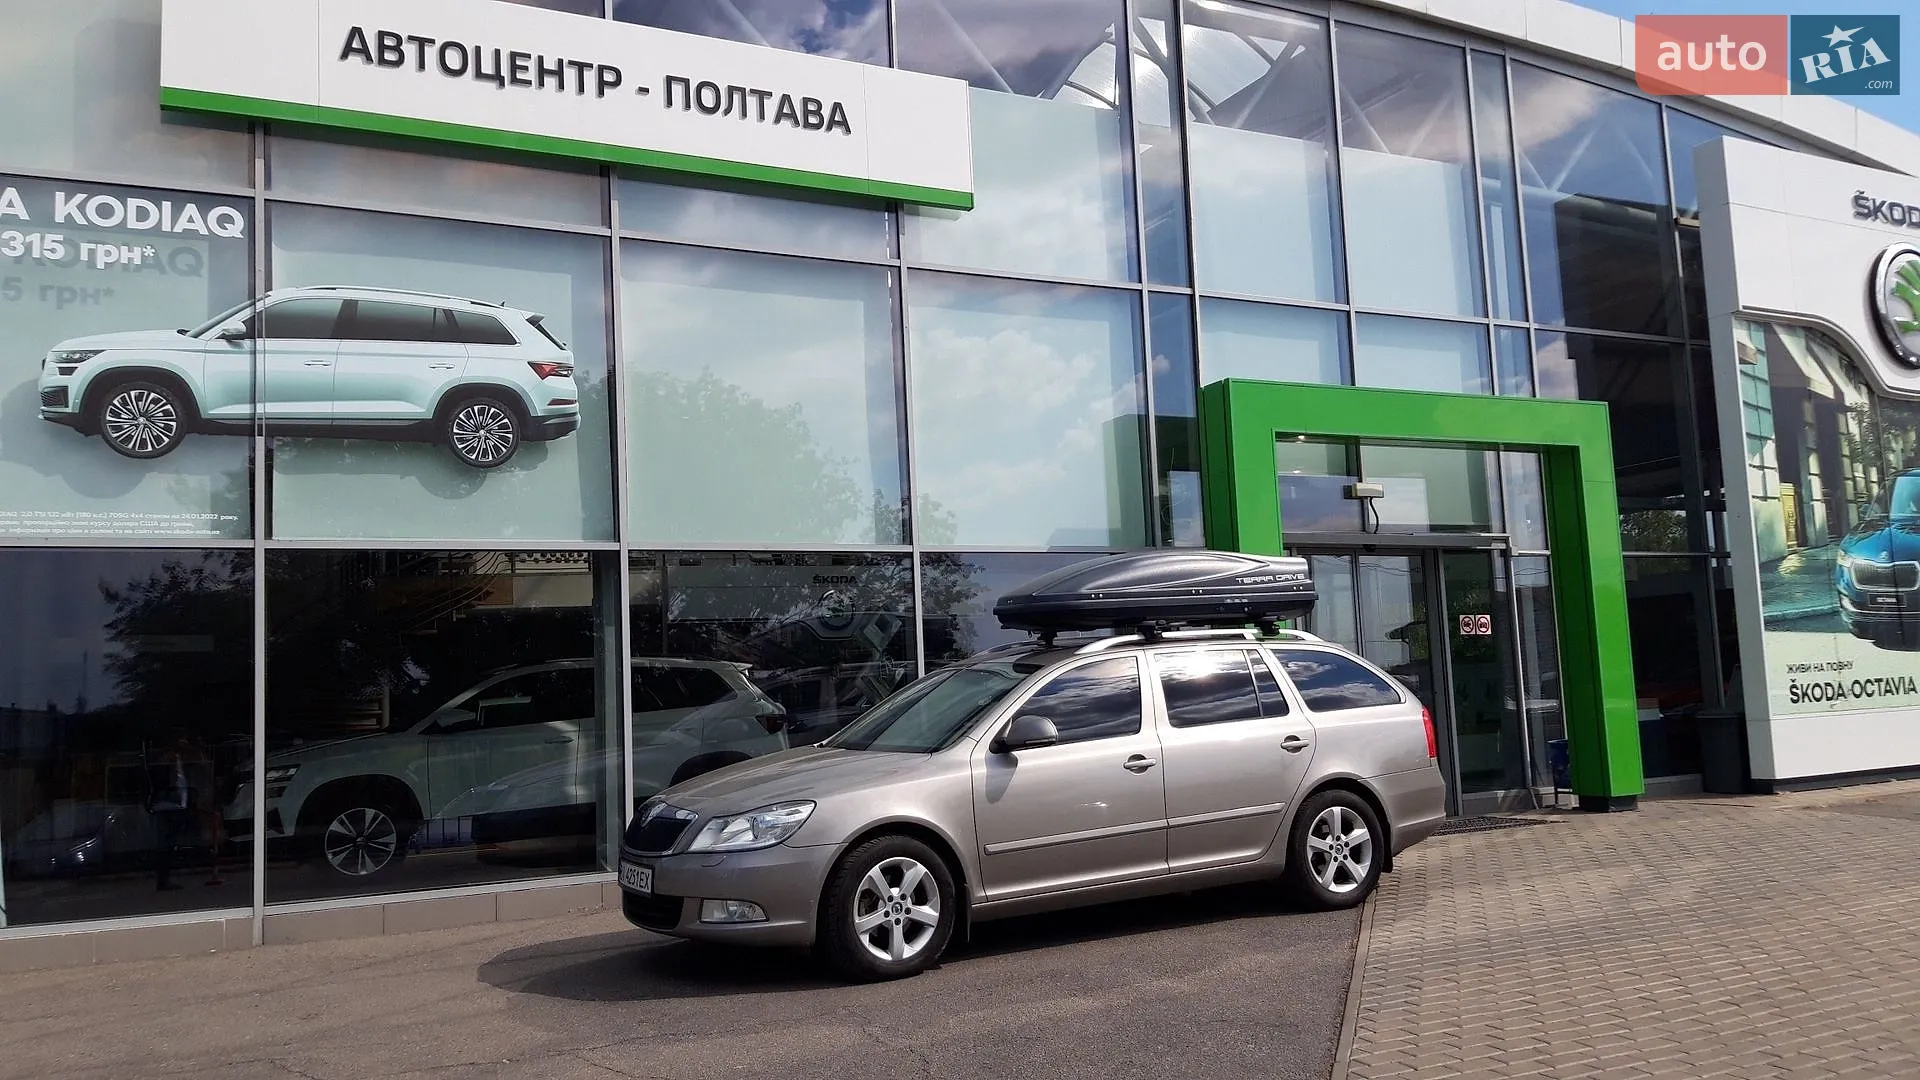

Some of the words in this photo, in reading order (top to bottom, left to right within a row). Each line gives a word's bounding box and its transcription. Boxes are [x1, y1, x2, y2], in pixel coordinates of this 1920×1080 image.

[339, 25, 623, 98] АВТОЦЕНТР
[664, 74, 852, 135] ПОЛТАВА
[54, 191, 245, 239] KODIAQ
[0, 230, 66, 260] 315
[812, 574, 857, 584] ŠKODA
[1236, 576, 1273, 584] TERRA
[1789, 678, 1847, 704] ŠKODA
[1851, 676, 1918, 698] OCTAVIA
